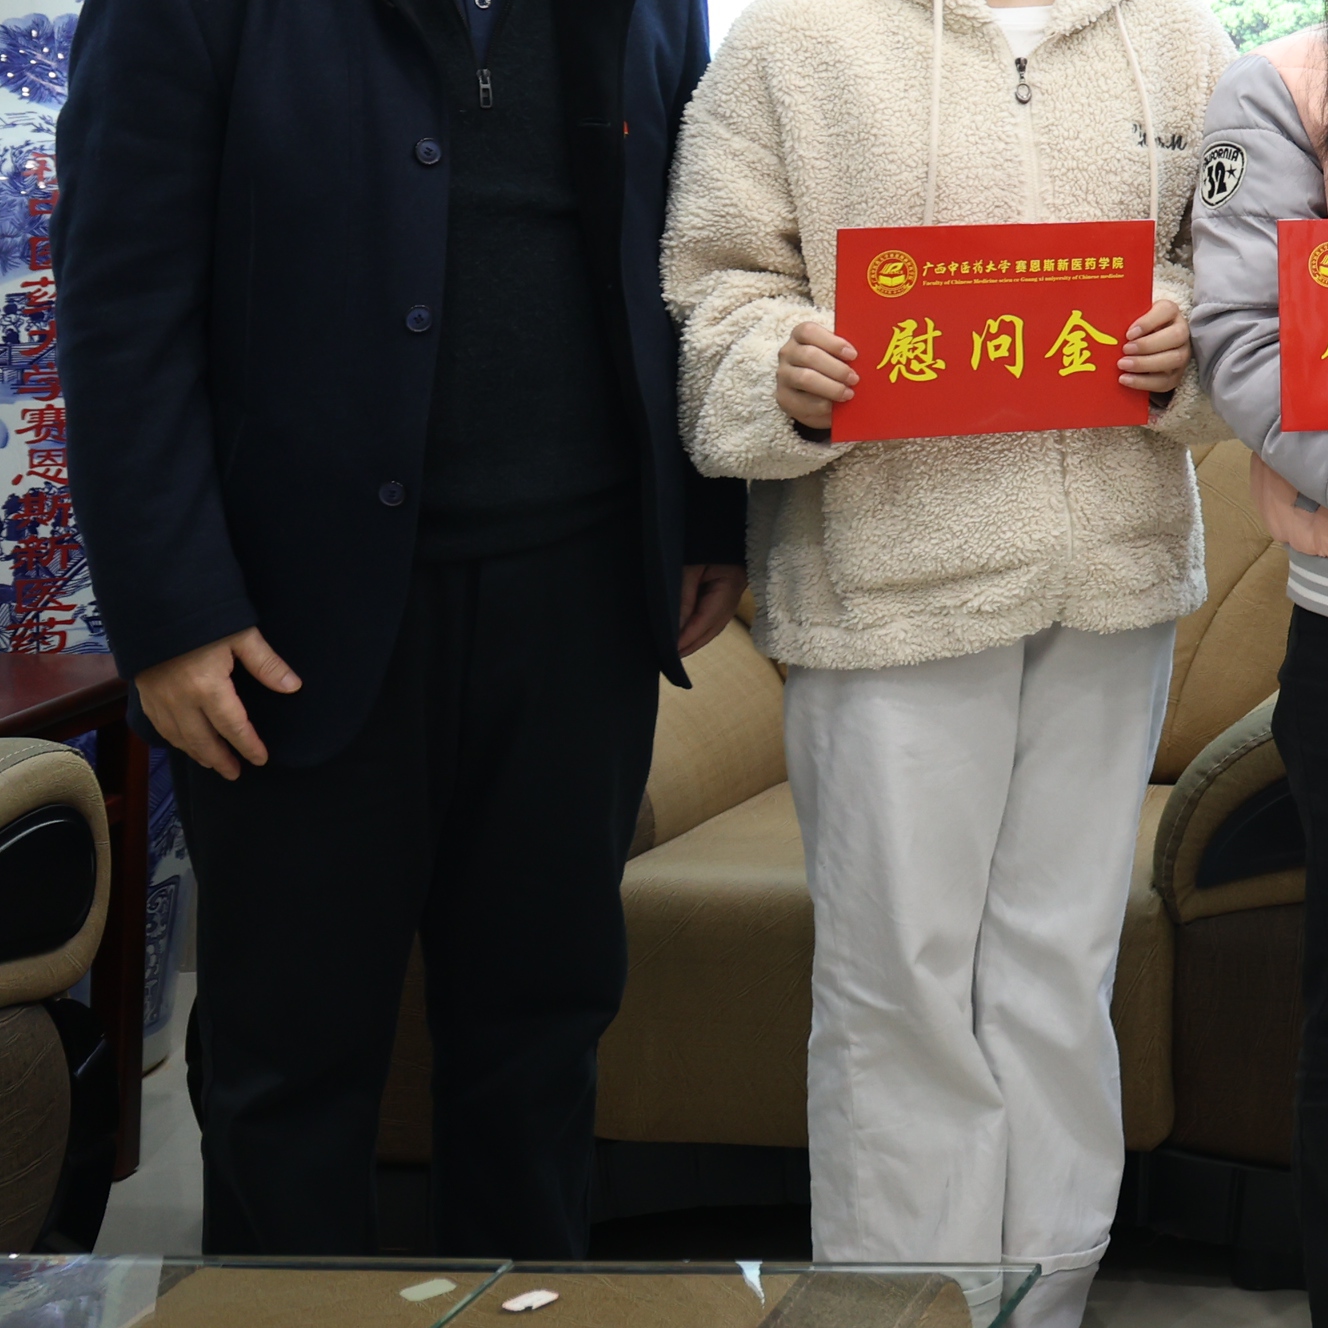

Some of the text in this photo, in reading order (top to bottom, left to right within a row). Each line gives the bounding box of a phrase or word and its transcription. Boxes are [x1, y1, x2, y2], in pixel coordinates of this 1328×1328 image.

[921, 255, 1124, 277] 广西中医药大学 赛恩斯新医药学院
[877, 310, 1118, 382] 慰问金
